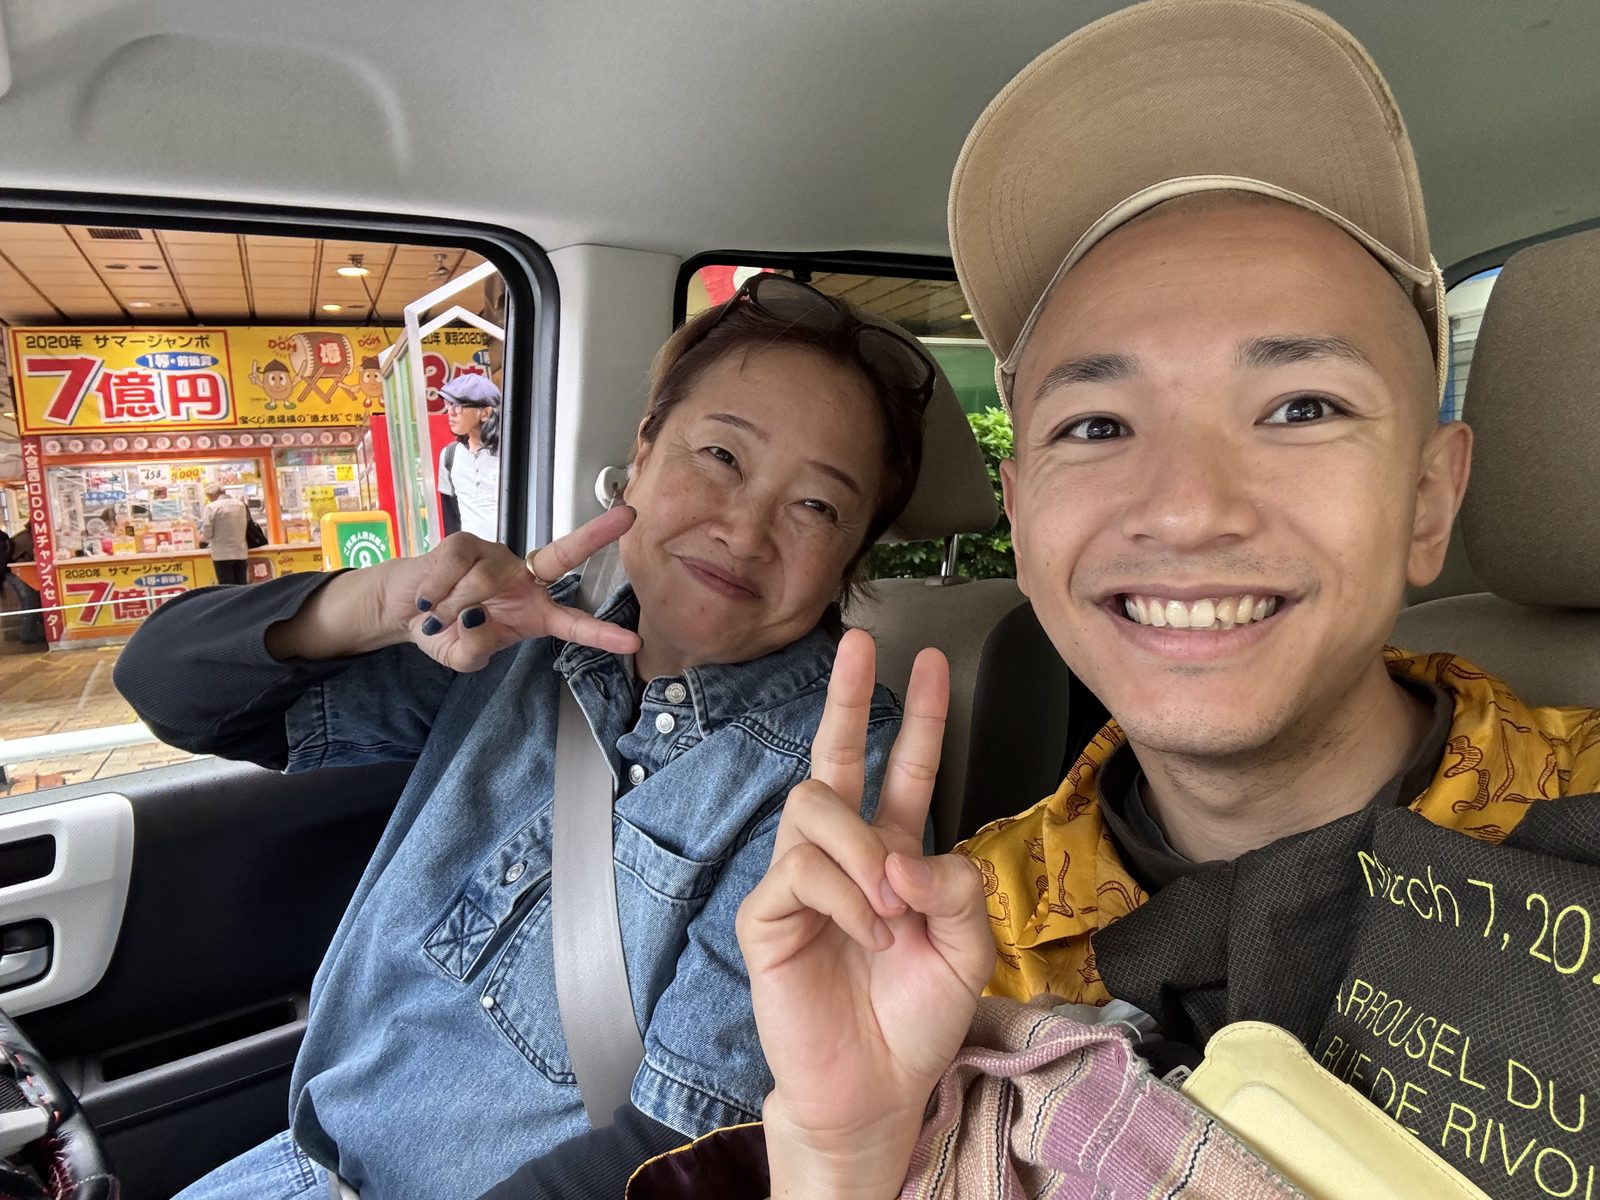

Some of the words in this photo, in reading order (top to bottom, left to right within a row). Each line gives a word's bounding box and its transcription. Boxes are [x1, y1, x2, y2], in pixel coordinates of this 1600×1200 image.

[26, 335, 83, 349] 2020年
[93, 334, 210, 349] サマージャンボ
[26, 356, 225, 423] 7億円
[24, 442, 57, 640] 大宮西口DOMチャンスセター
[65, 568, 101, 579] 2020年
[108, 563, 183, 577] サマージャンボ
[1507, 1059, 1585, 1132] DU
